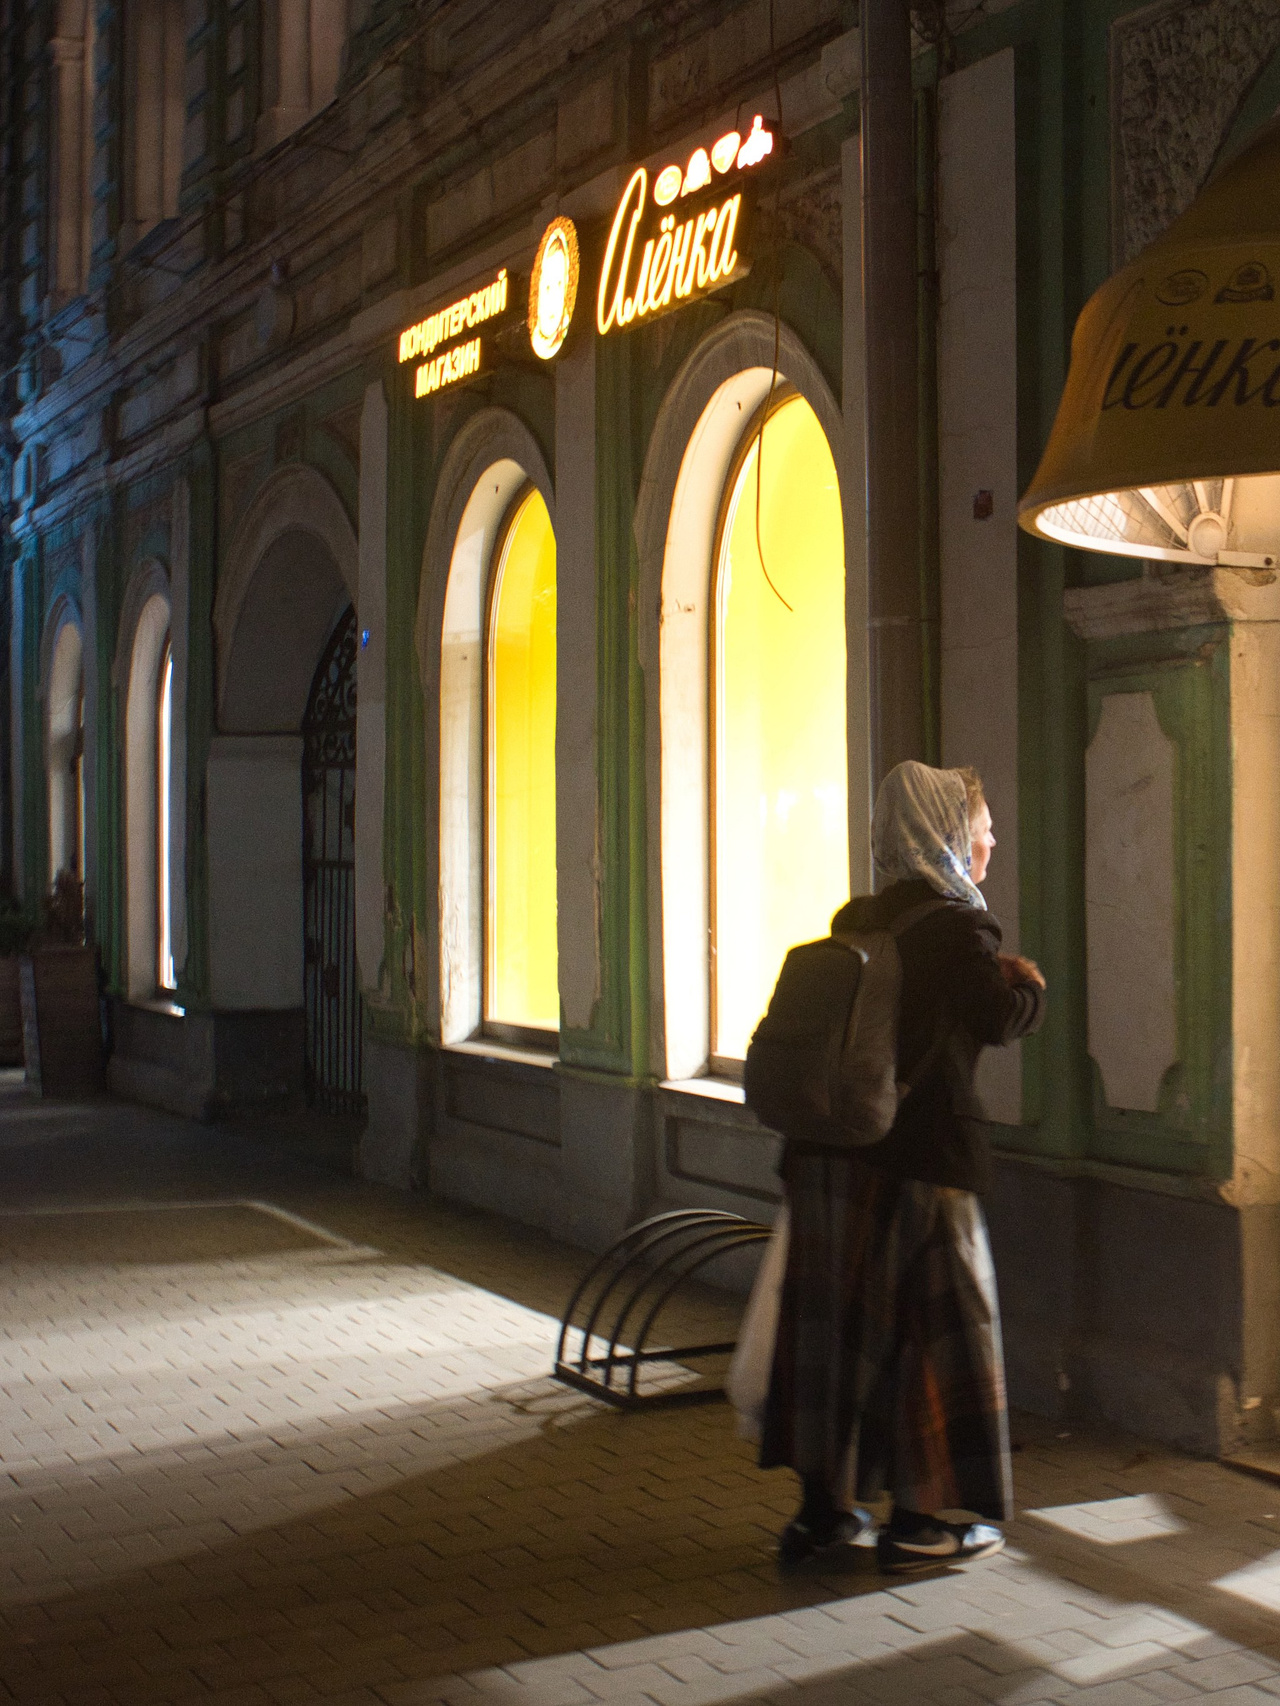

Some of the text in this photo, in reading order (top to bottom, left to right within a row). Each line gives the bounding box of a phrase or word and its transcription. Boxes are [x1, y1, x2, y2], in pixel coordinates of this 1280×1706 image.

[598, 167, 741, 335] Алёнка
[399, 268, 508, 364] КОНДИТЕРСКИЙ
[415, 336, 481, 399] МАГАЗИН
